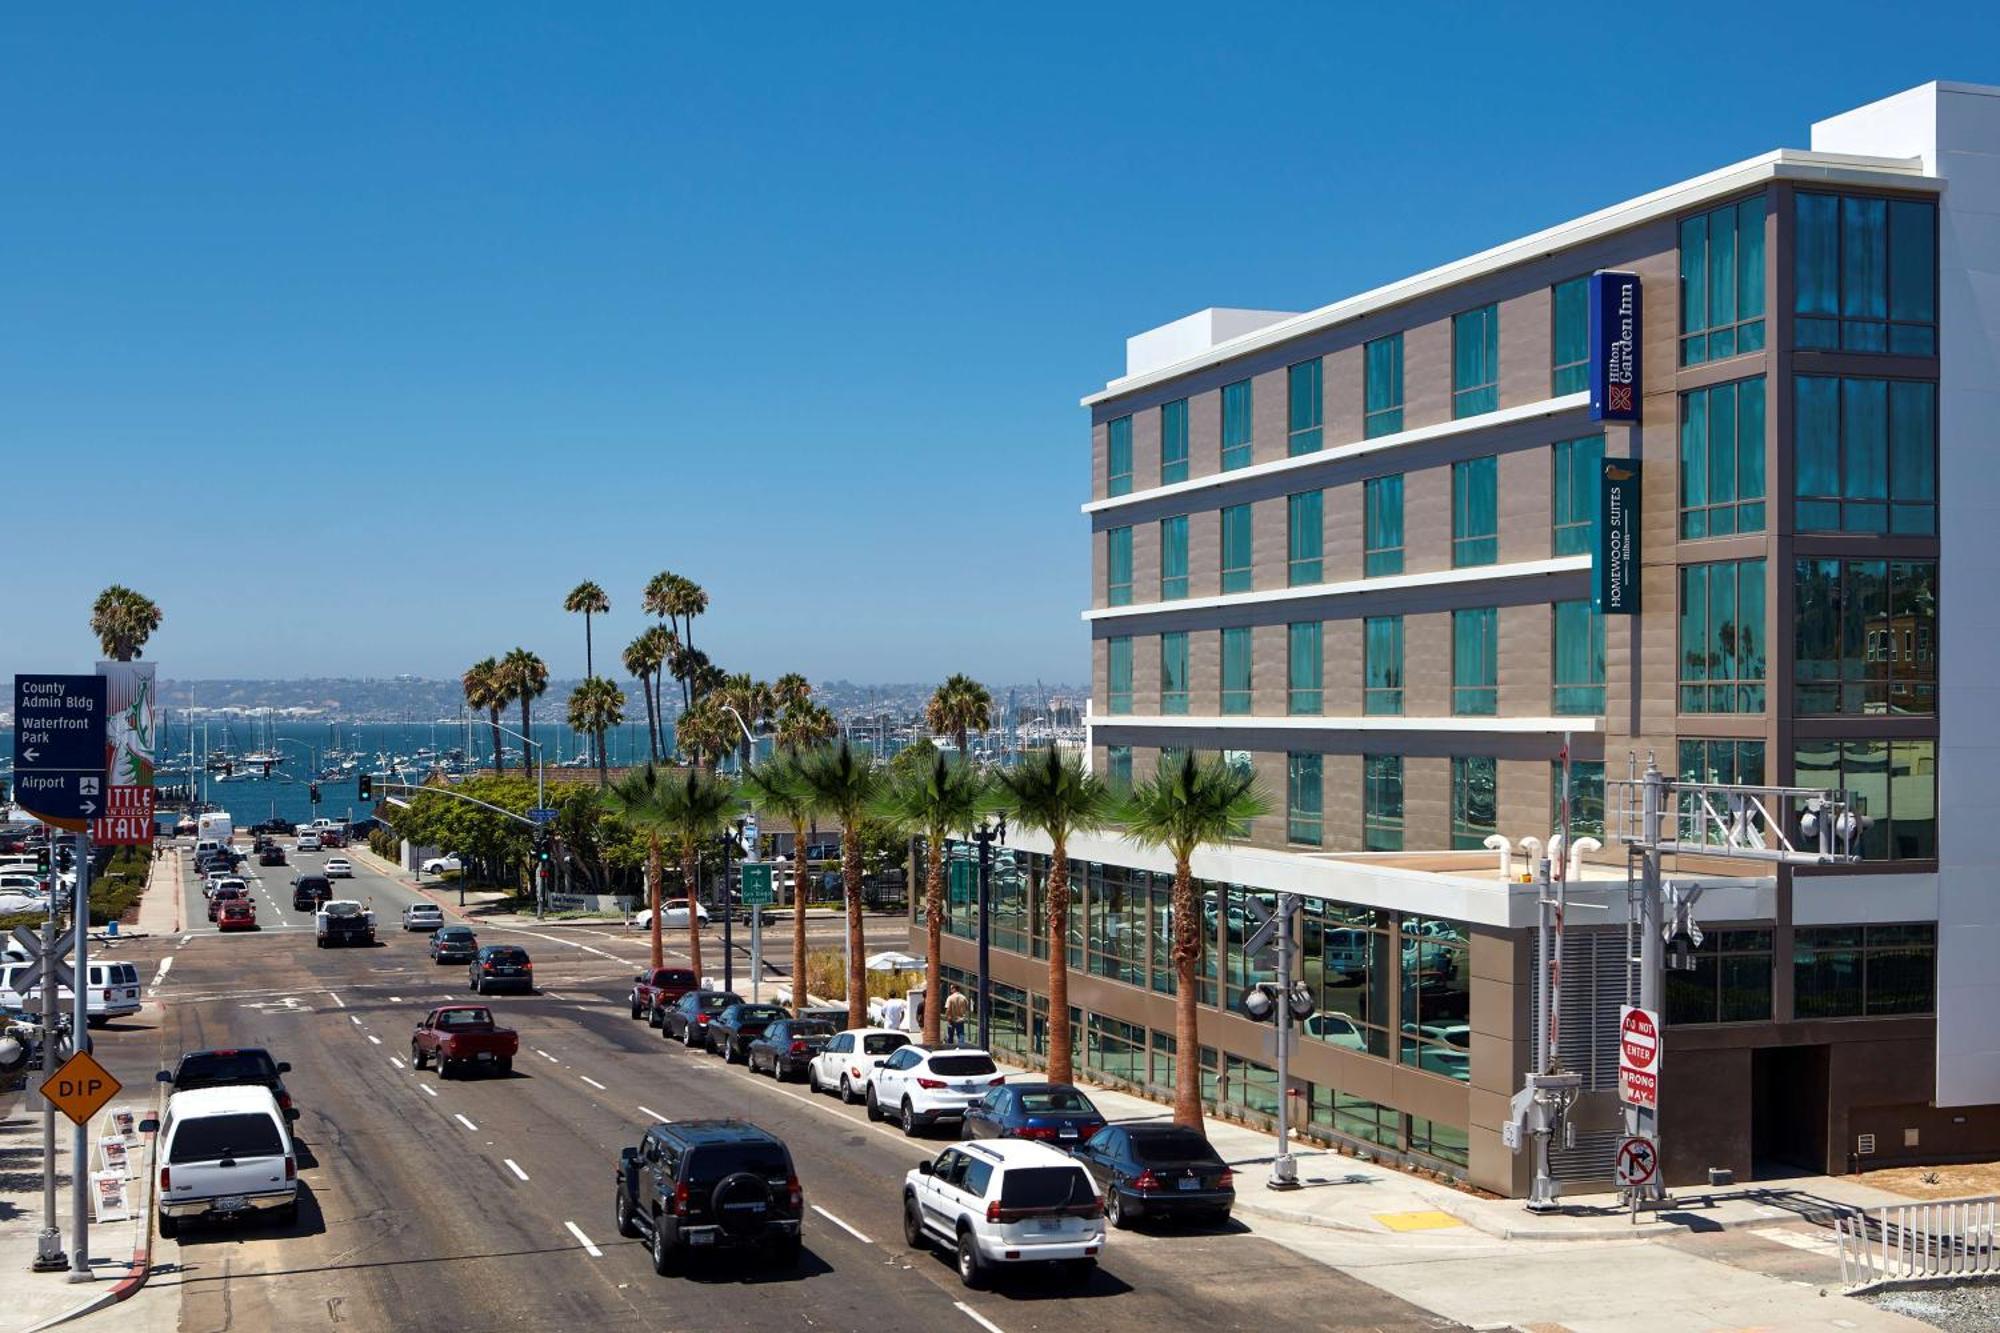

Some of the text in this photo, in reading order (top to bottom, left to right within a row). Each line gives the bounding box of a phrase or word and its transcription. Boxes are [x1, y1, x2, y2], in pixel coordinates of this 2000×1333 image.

[1619, 283, 1633, 384] Garden Inn
[1609, 342, 1620, 383] Hilton
[1611, 487, 1621, 608] HOMEWOOD SUITES
[22, 682, 65, 697] County
[22, 695, 93, 712] Admin Bldg
[22, 716, 89, 729] Waterfront
[22, 731, 49, 744] Park
[22, 776, 65, 791] Airport
[107, 788, 151, 807] ITTLE
[98, 818, 150, 839] ITALY
[1626, 1018, 1653, 1035] DO NOT
[1627, 1044, 1650, 1060] ENTER
[1622, 1070, 1655, 1089] WRONG
[60, 1080, 102, 1097] DIP
[1627, 1087, 1648, 1102] WAY
